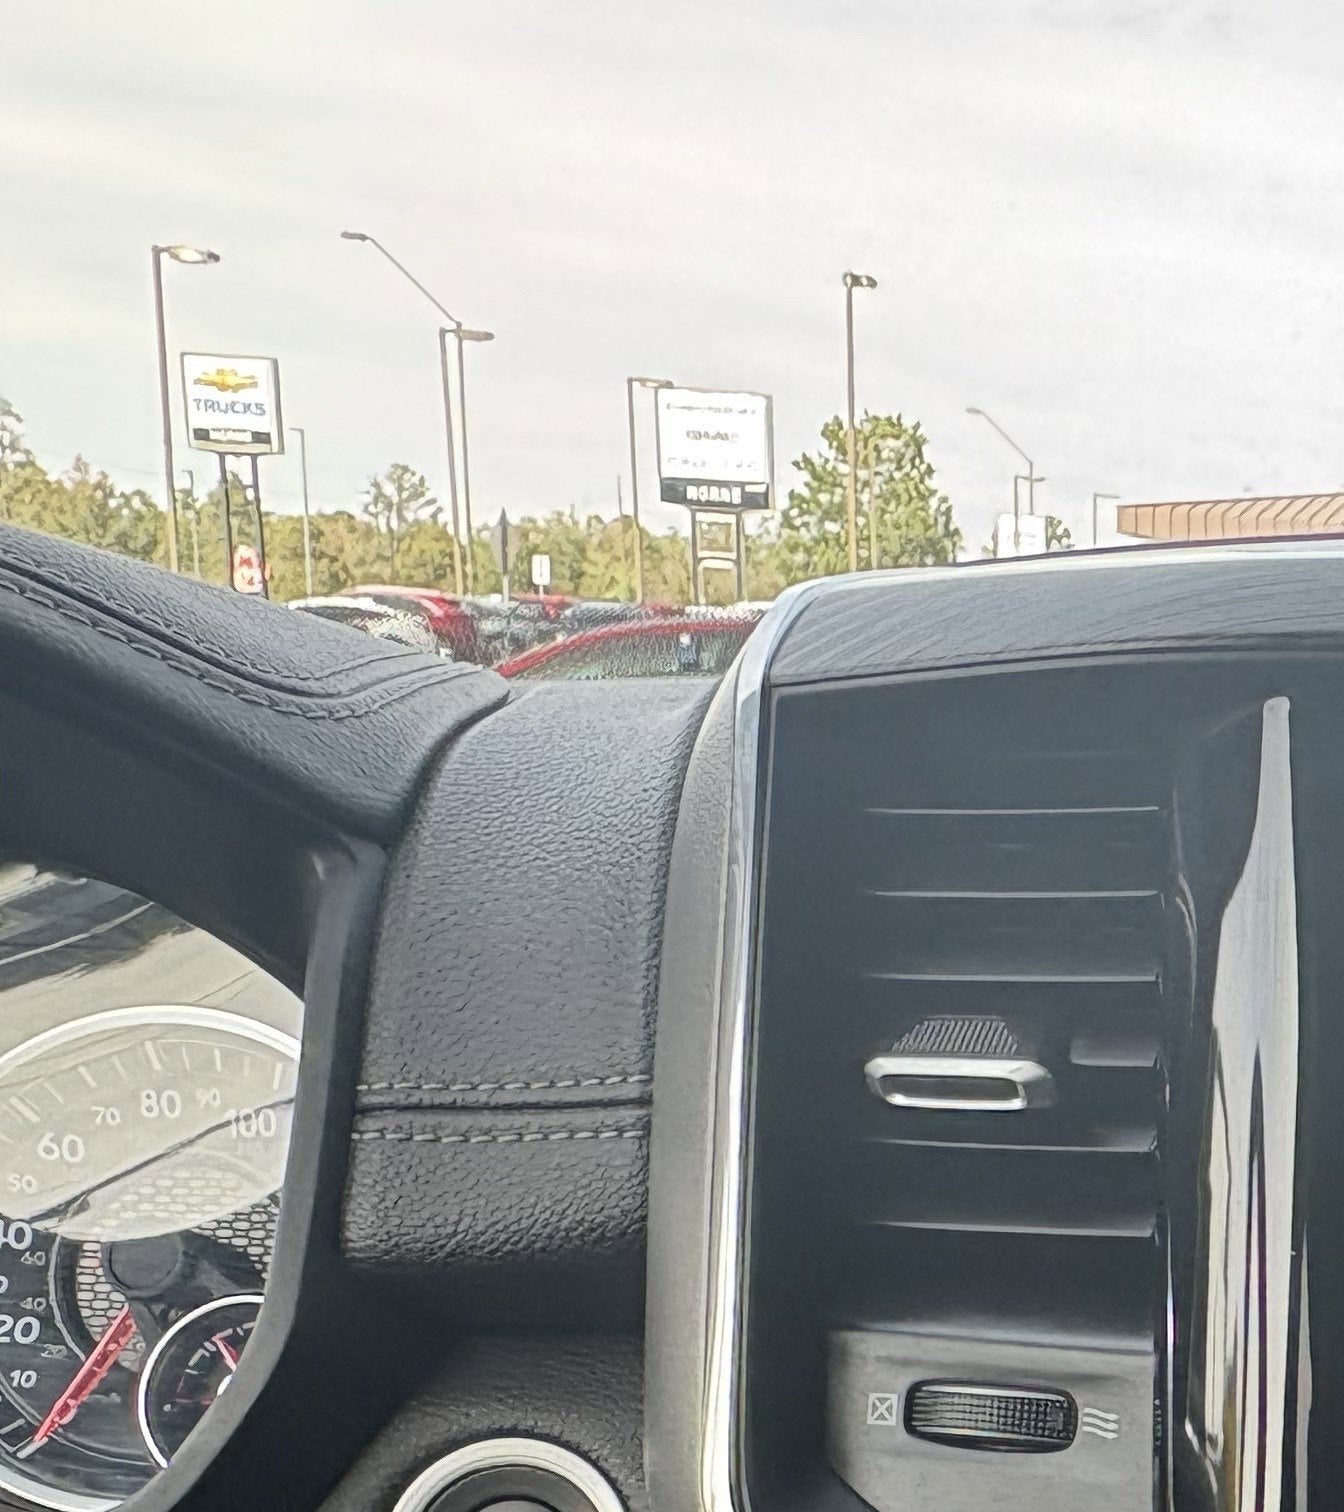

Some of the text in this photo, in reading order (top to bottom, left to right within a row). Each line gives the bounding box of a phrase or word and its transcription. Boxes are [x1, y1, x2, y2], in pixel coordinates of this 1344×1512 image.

[91, 1106, 121, 1125] 70
[141, 1089, 182, 1119] 80
[225, 1107, 276, 1138] 100
[37, 1132, 85, 1163] 60
[9, 1174, 37, 1193] 50
[0, 1314, 41, 1344] 20
[10, 1370, 37, 1388] 10
